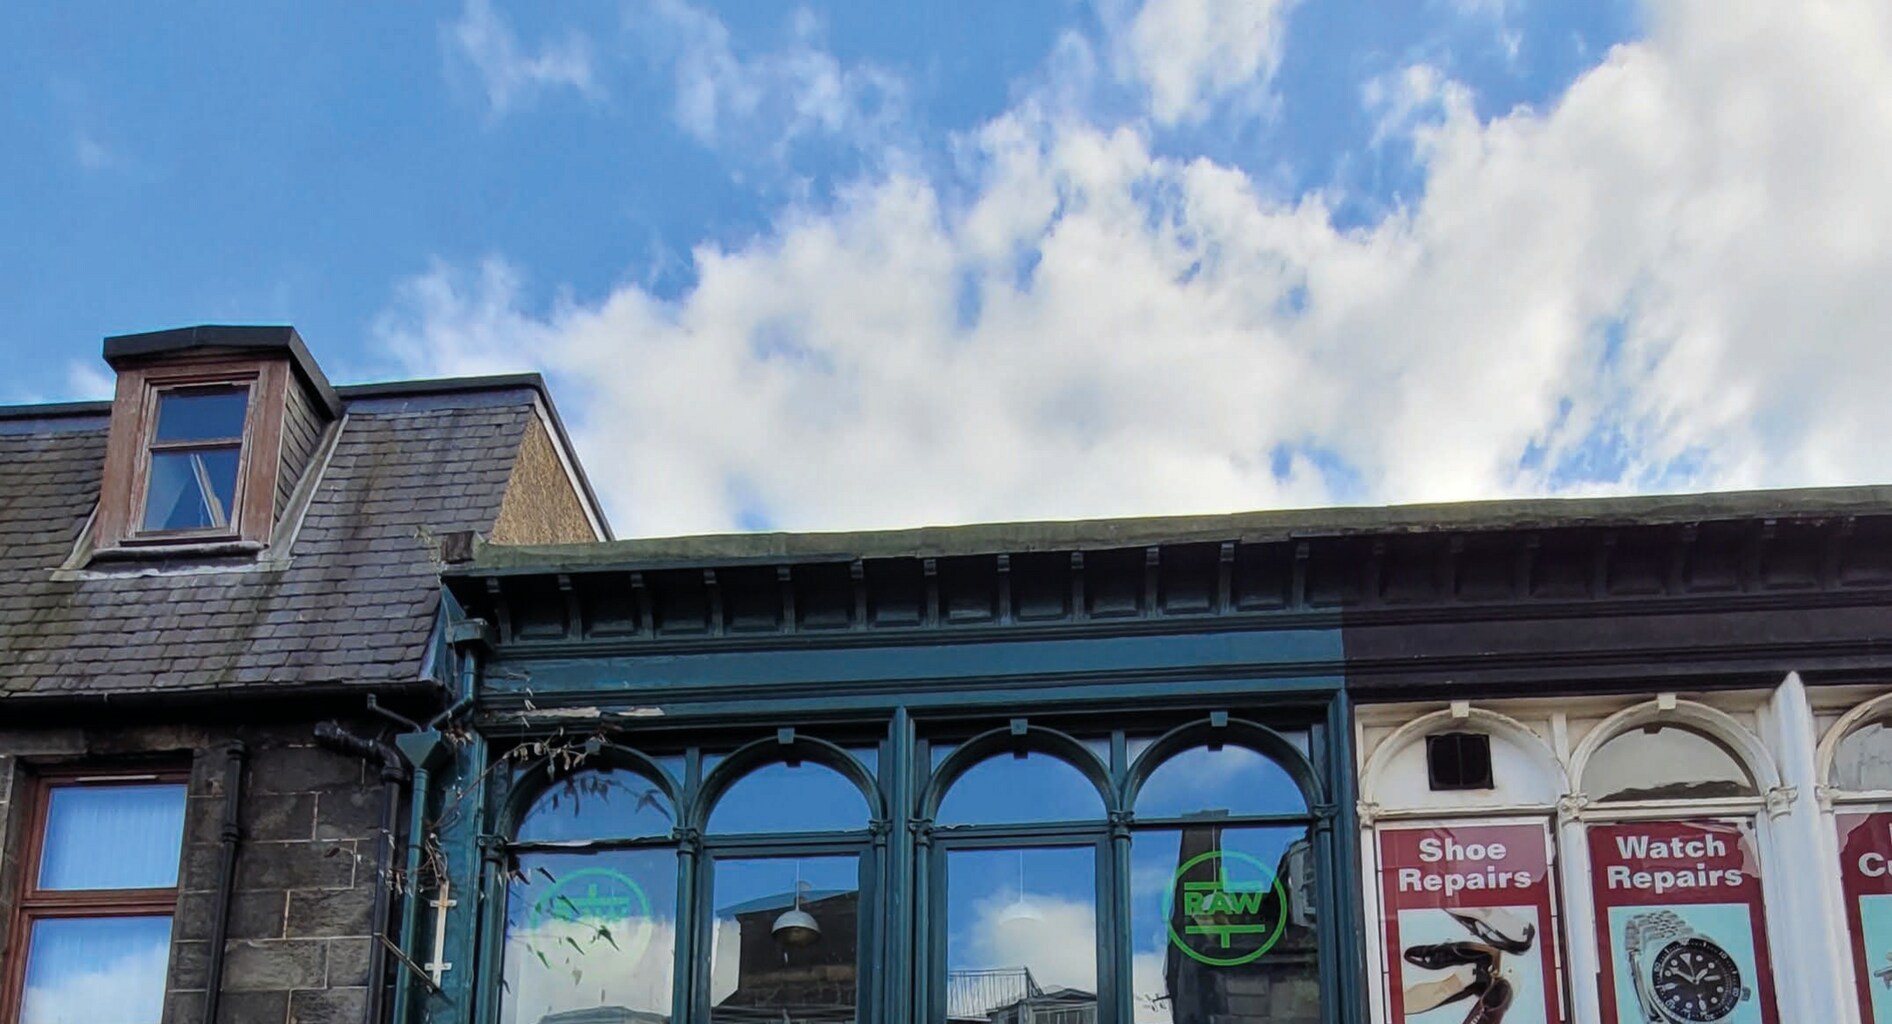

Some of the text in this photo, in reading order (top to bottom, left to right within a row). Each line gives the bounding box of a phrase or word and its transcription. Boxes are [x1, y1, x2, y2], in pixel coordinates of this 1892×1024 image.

[1419, 837, 1506, 862] Shoe
[1615, 833, 1726, 859] Watch
[1399, 865, 1532, 896] Repairs
[1607, 863, 1743, 894] Repairs
[1184, 891, 1263, 915] RAW
